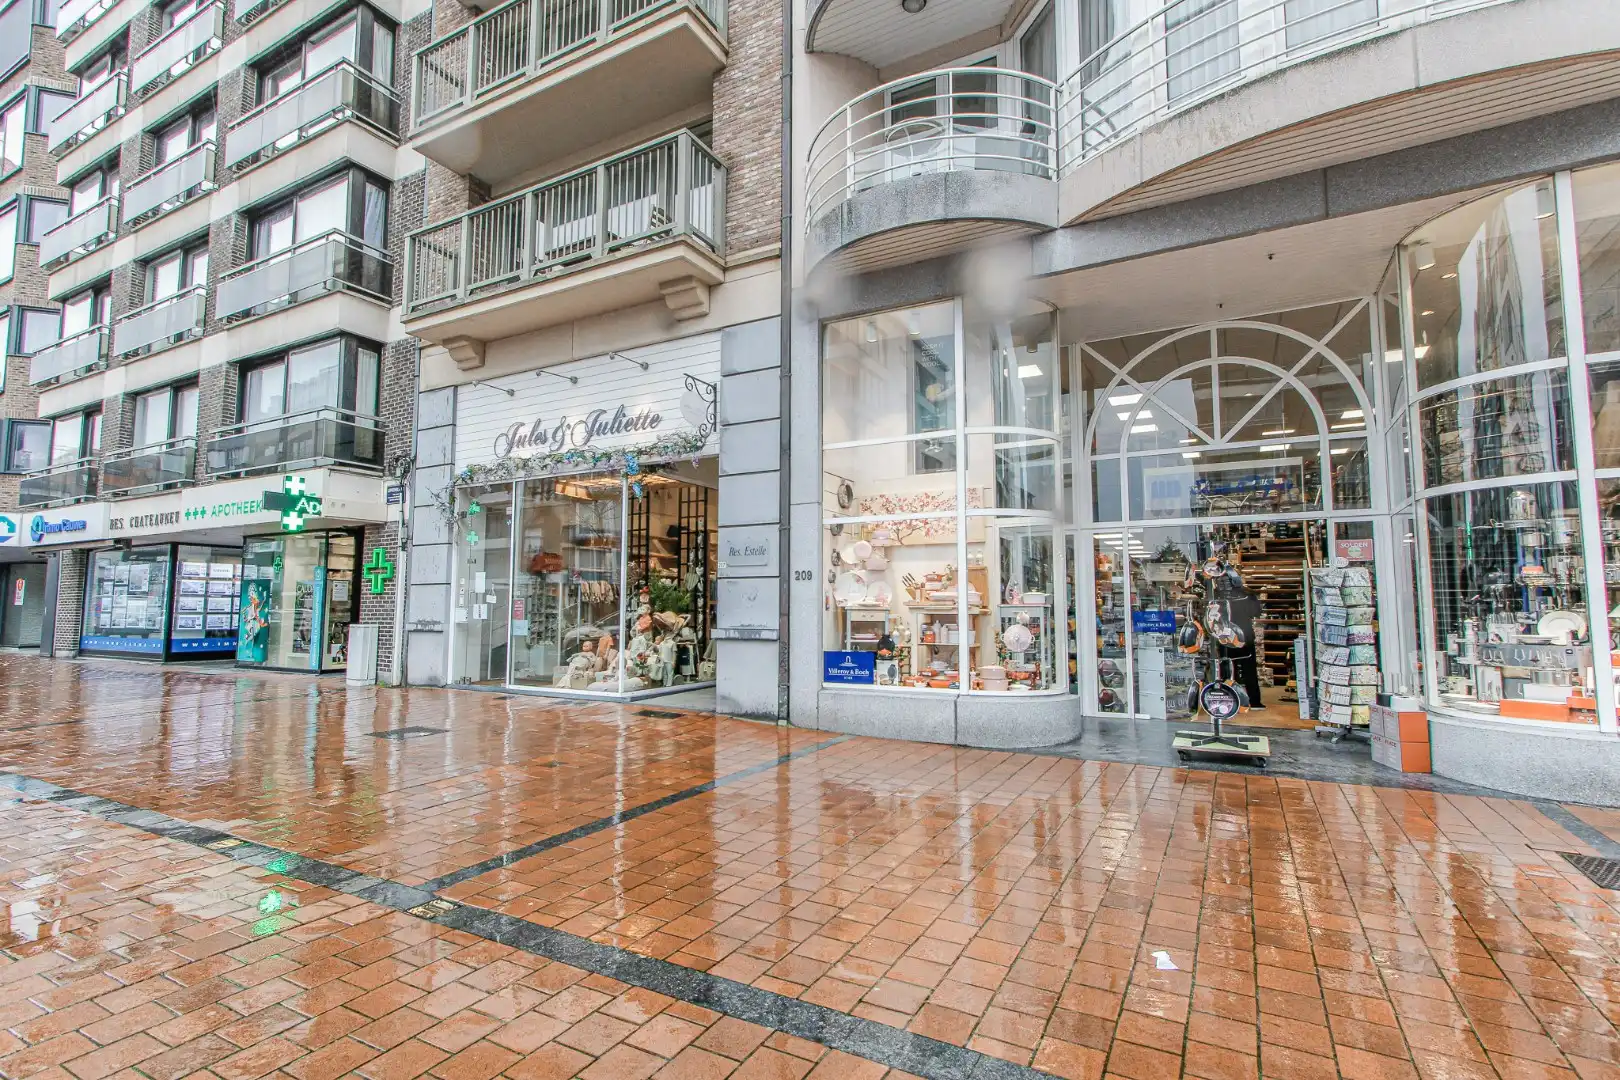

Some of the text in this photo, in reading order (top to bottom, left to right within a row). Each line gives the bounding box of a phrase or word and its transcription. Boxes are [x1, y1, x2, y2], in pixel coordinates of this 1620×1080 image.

[494, 404, 663, 458] Jules & Juliette
[211, 500, 263, 517] APOTHEEK
[744, 545, 767, 557] Estelle
[794, 570, 813, 581] 209
